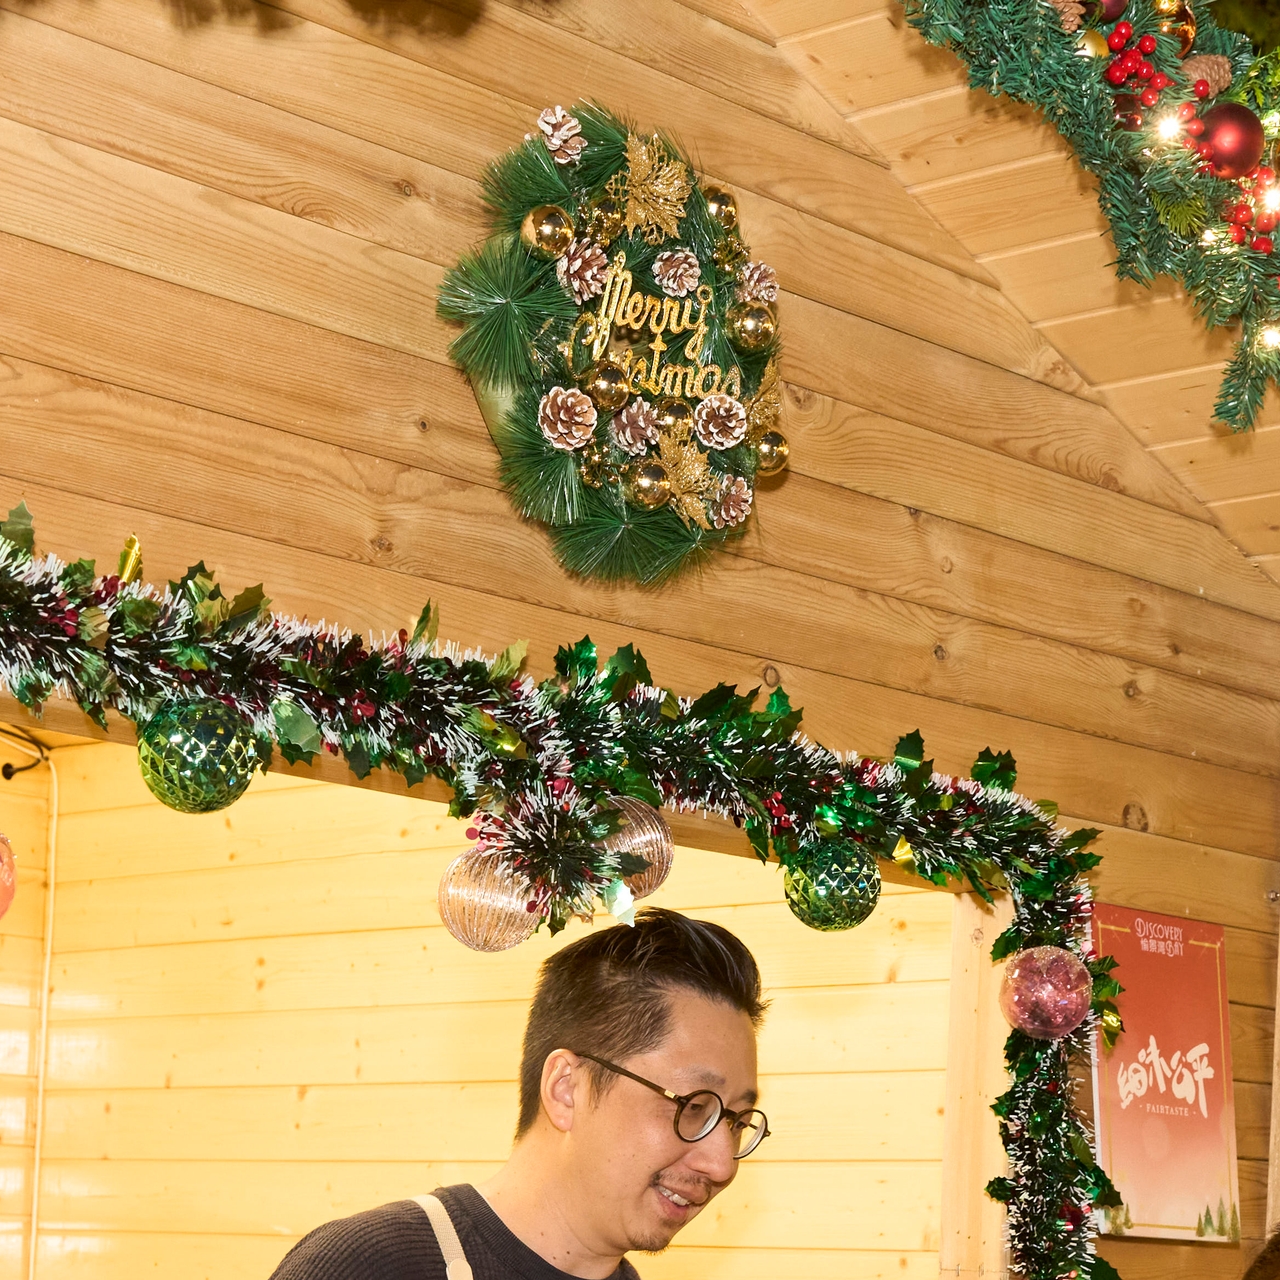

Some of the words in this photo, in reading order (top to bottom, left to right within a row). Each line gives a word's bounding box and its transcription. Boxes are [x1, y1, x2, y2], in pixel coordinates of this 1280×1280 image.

[598, 256, 711, 360] Merry
[1135, 918, 1183, 941] DISCOVERY
[1166, 941, 1184, 957] BAY
[1146, 1104, 1188, 1116] FAIRTASTE
